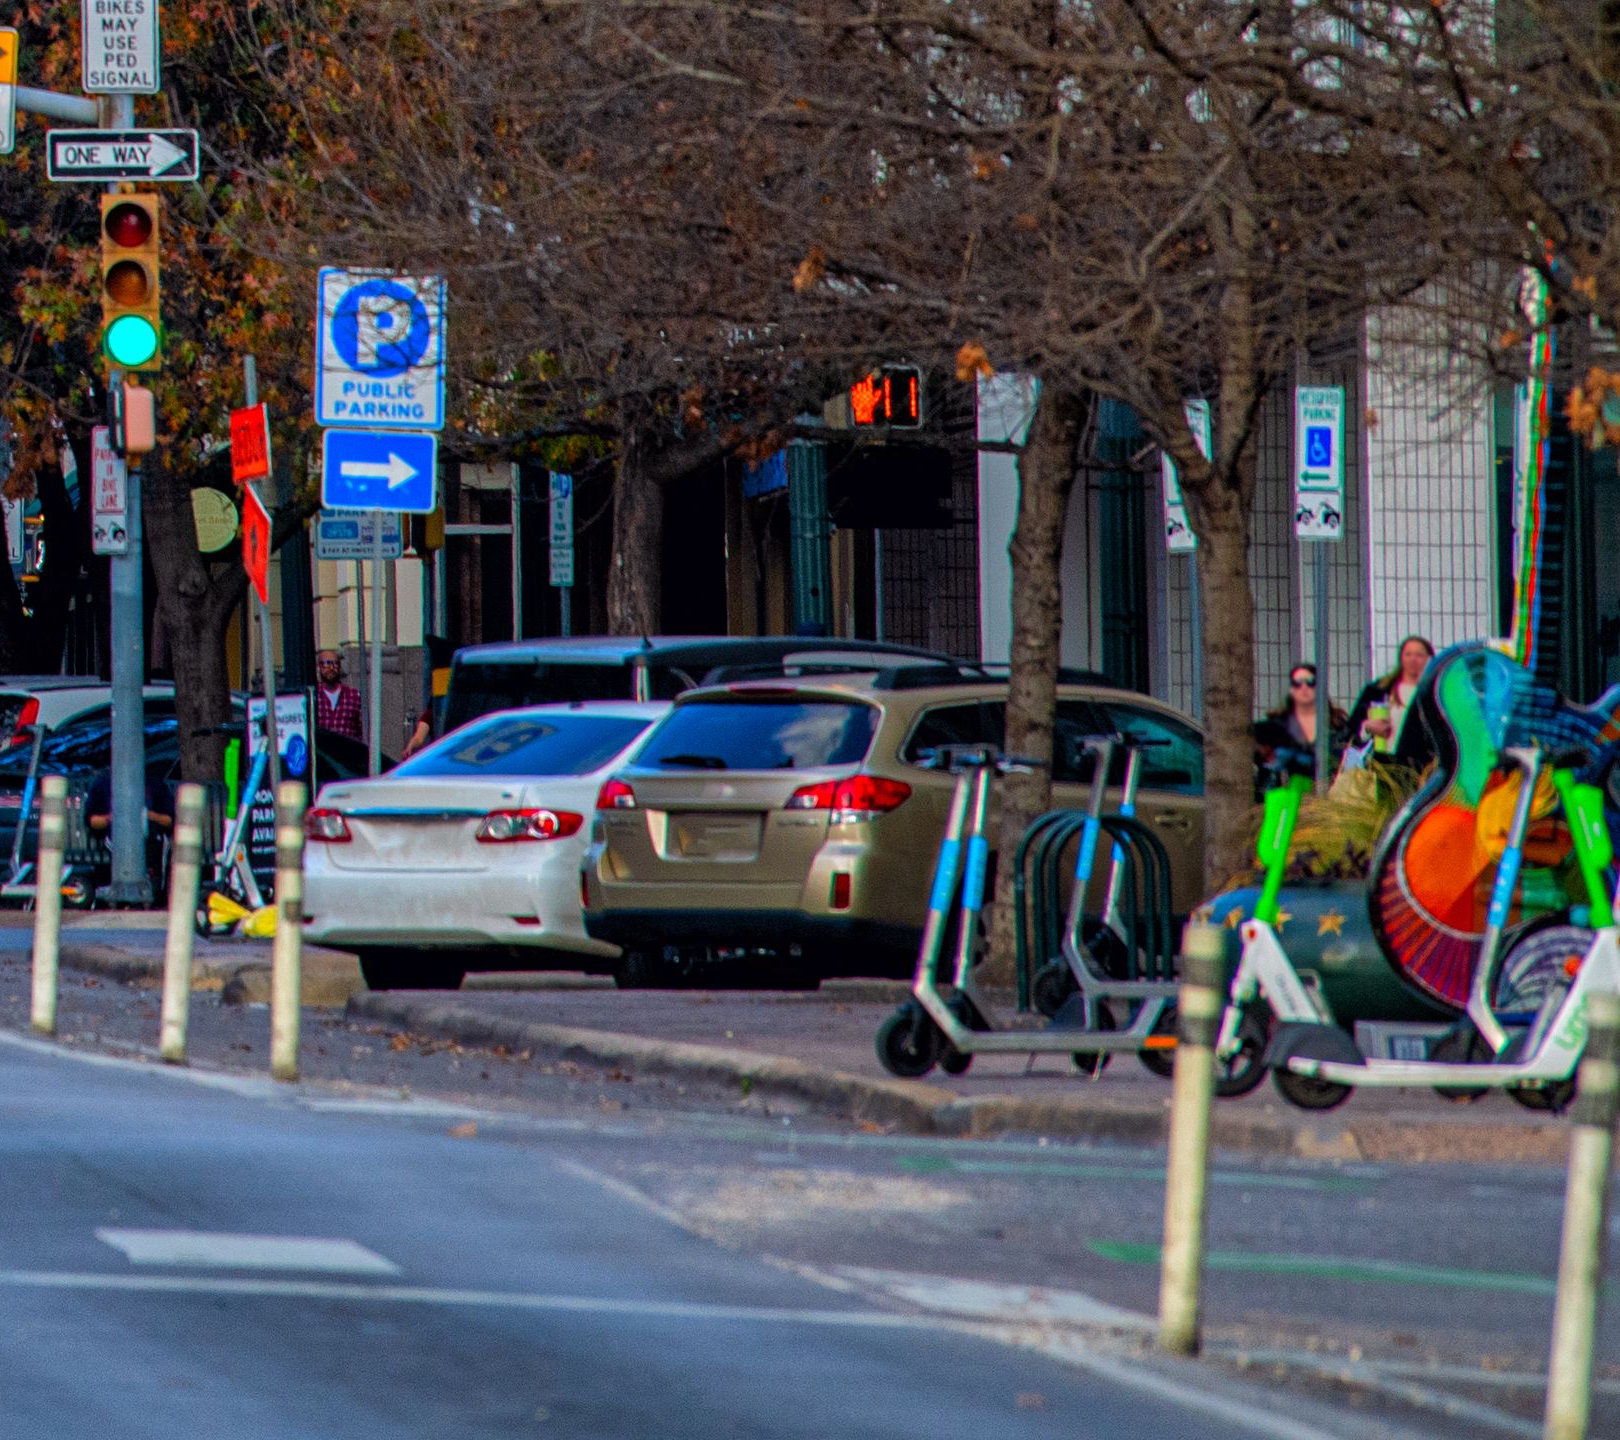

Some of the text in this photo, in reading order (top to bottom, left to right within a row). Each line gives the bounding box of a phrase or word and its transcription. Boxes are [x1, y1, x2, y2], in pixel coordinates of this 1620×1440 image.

[95, 0, 145, 15] BIKES
[101, 19, 138, 33] MAY
[103, 36, 137, 51] USE
[104, 53, 137, 68] PED
[90, 70, 153, 87] SIGNAL
[64, 145, 152, 165] ONE WAY
[356, 295, 415, 365] P
[342, 381, 417, 400] PUBLIC
[333, 400, 425, 420] PARKING
